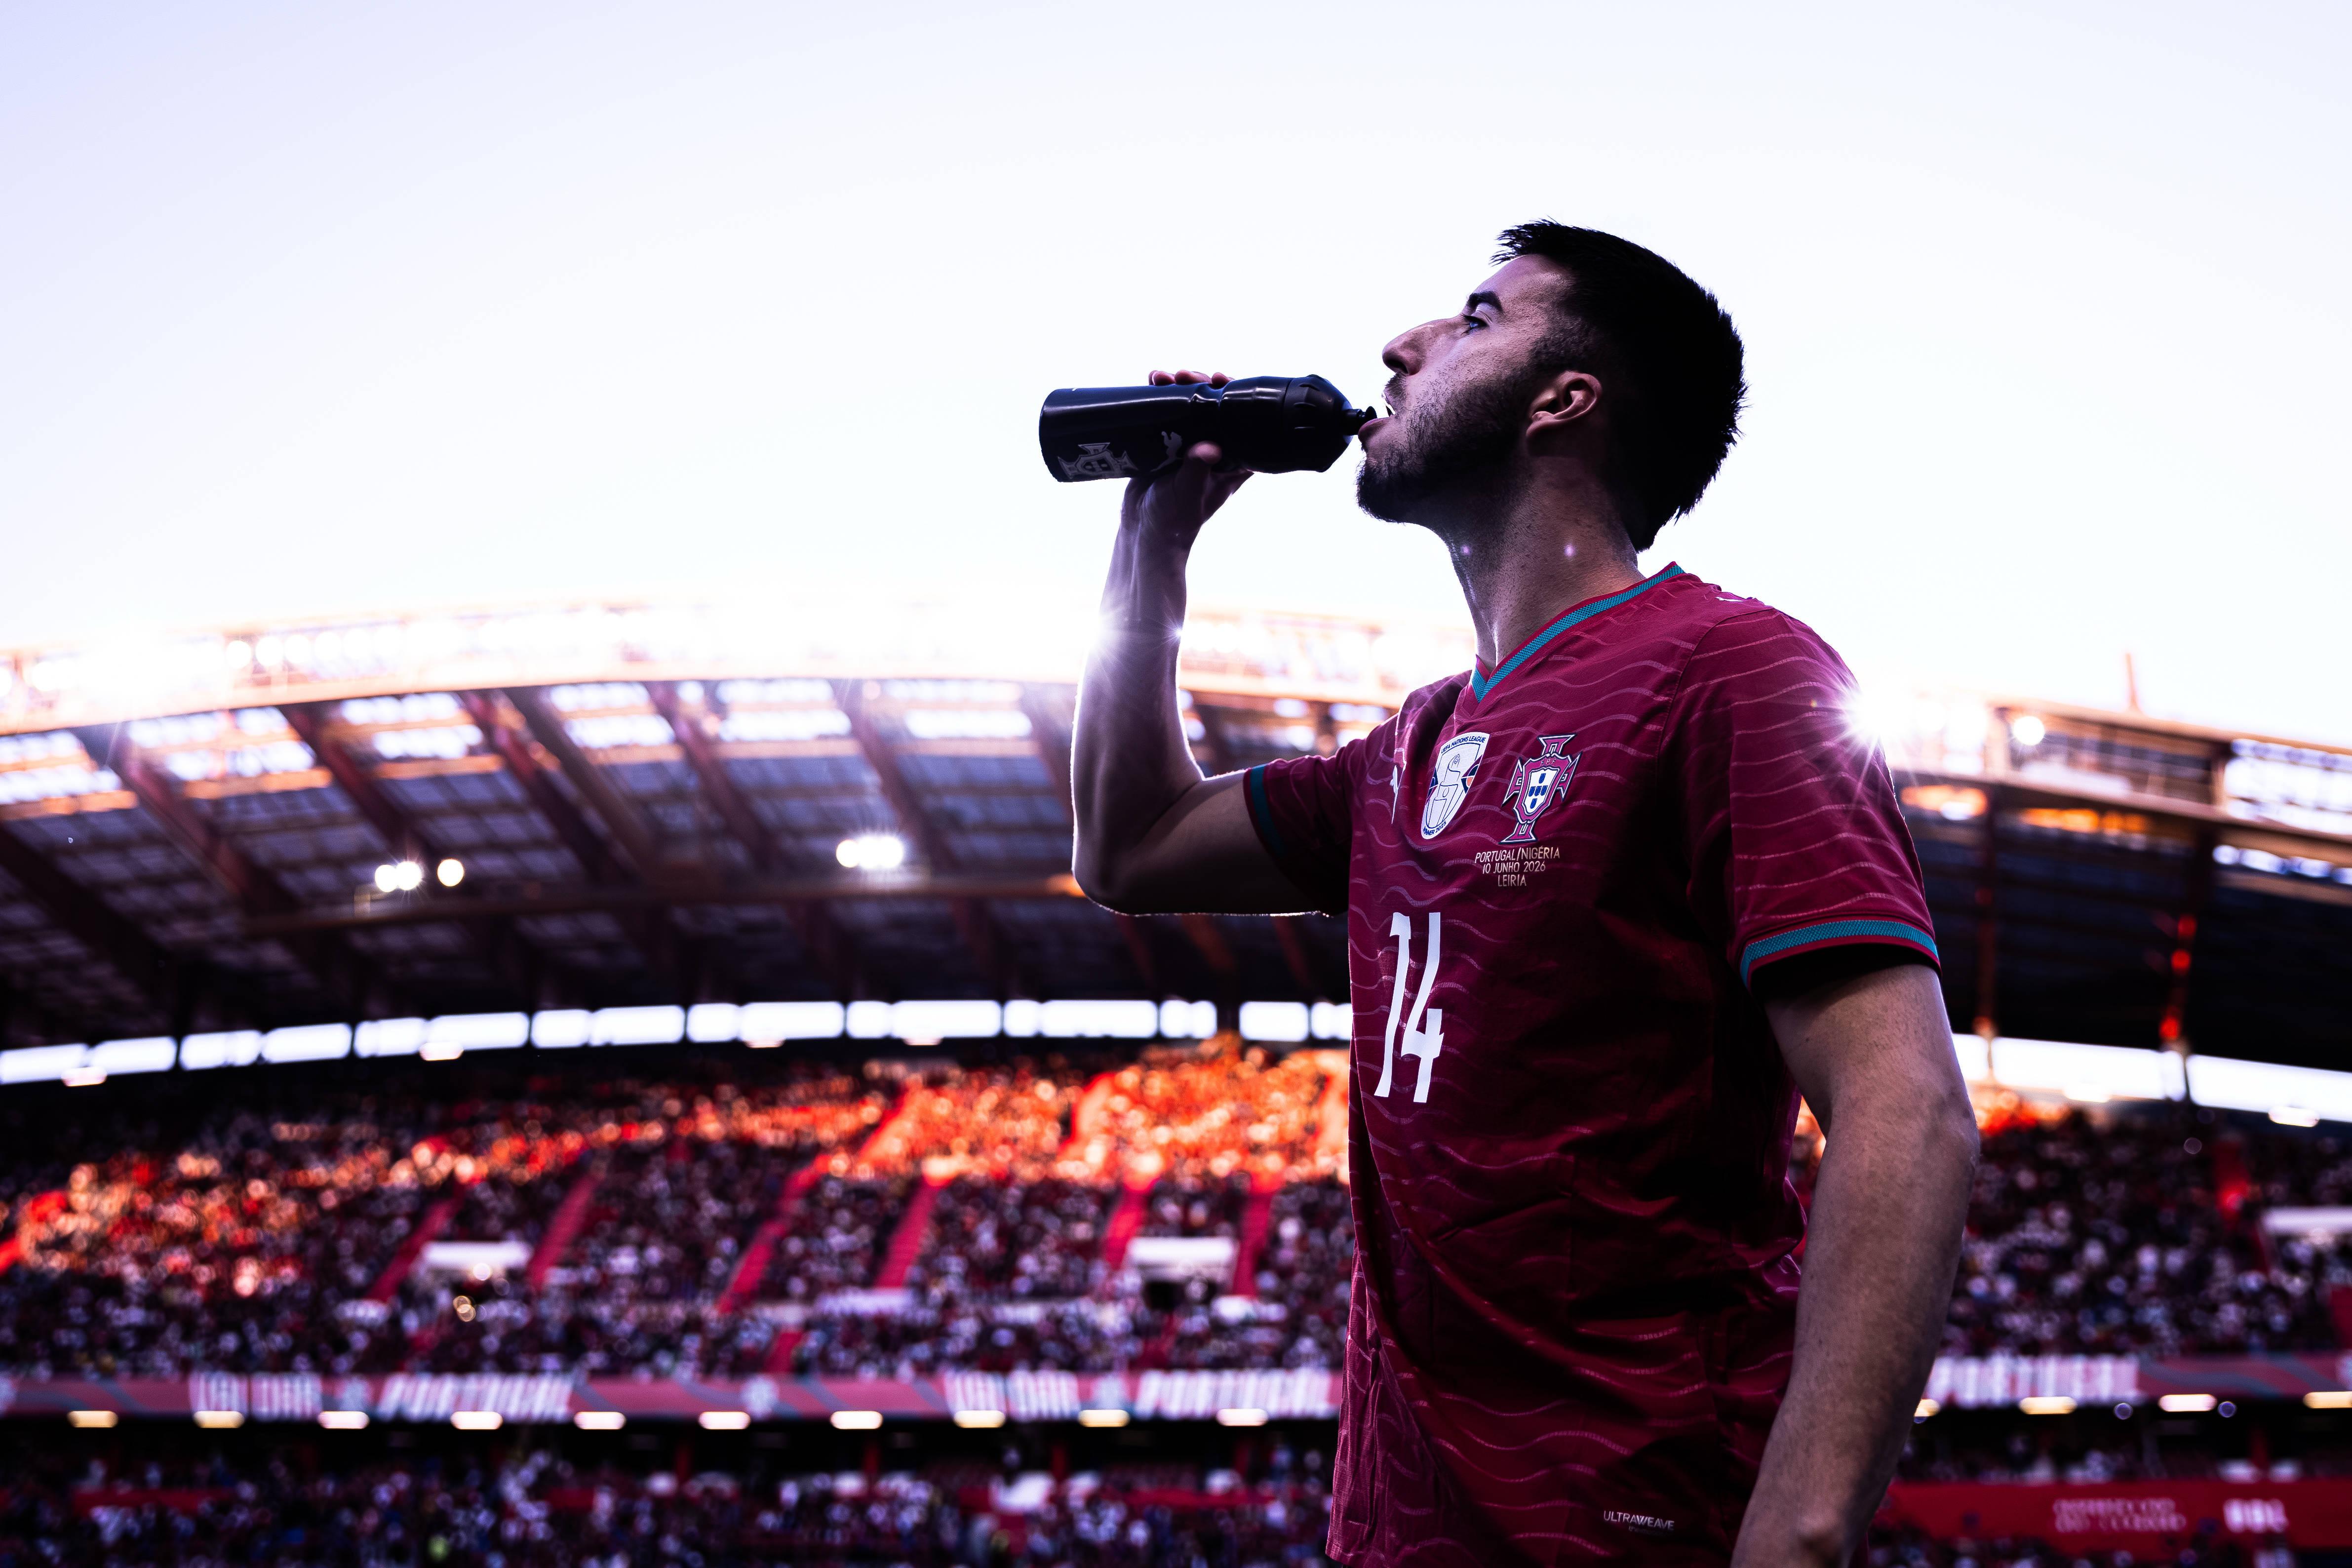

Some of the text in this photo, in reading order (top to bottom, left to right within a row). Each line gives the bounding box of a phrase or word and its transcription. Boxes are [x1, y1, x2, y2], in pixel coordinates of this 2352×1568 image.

[1451, 736, 1469, 747] NATIONS
[1423, 821, 1447, 835] WINNER 2025
[1474, 845, 1560, 863] PORTUGAL/NIGÉRIA
[1483, 861, 1546, 874] 10 JUNHO 2026
[1498, 874, 1527, 887] LEIRIA
[1373, 912, 1445, 1103] 14
[1604, 1510, 1675, 1530] ULTRAWEAVE
